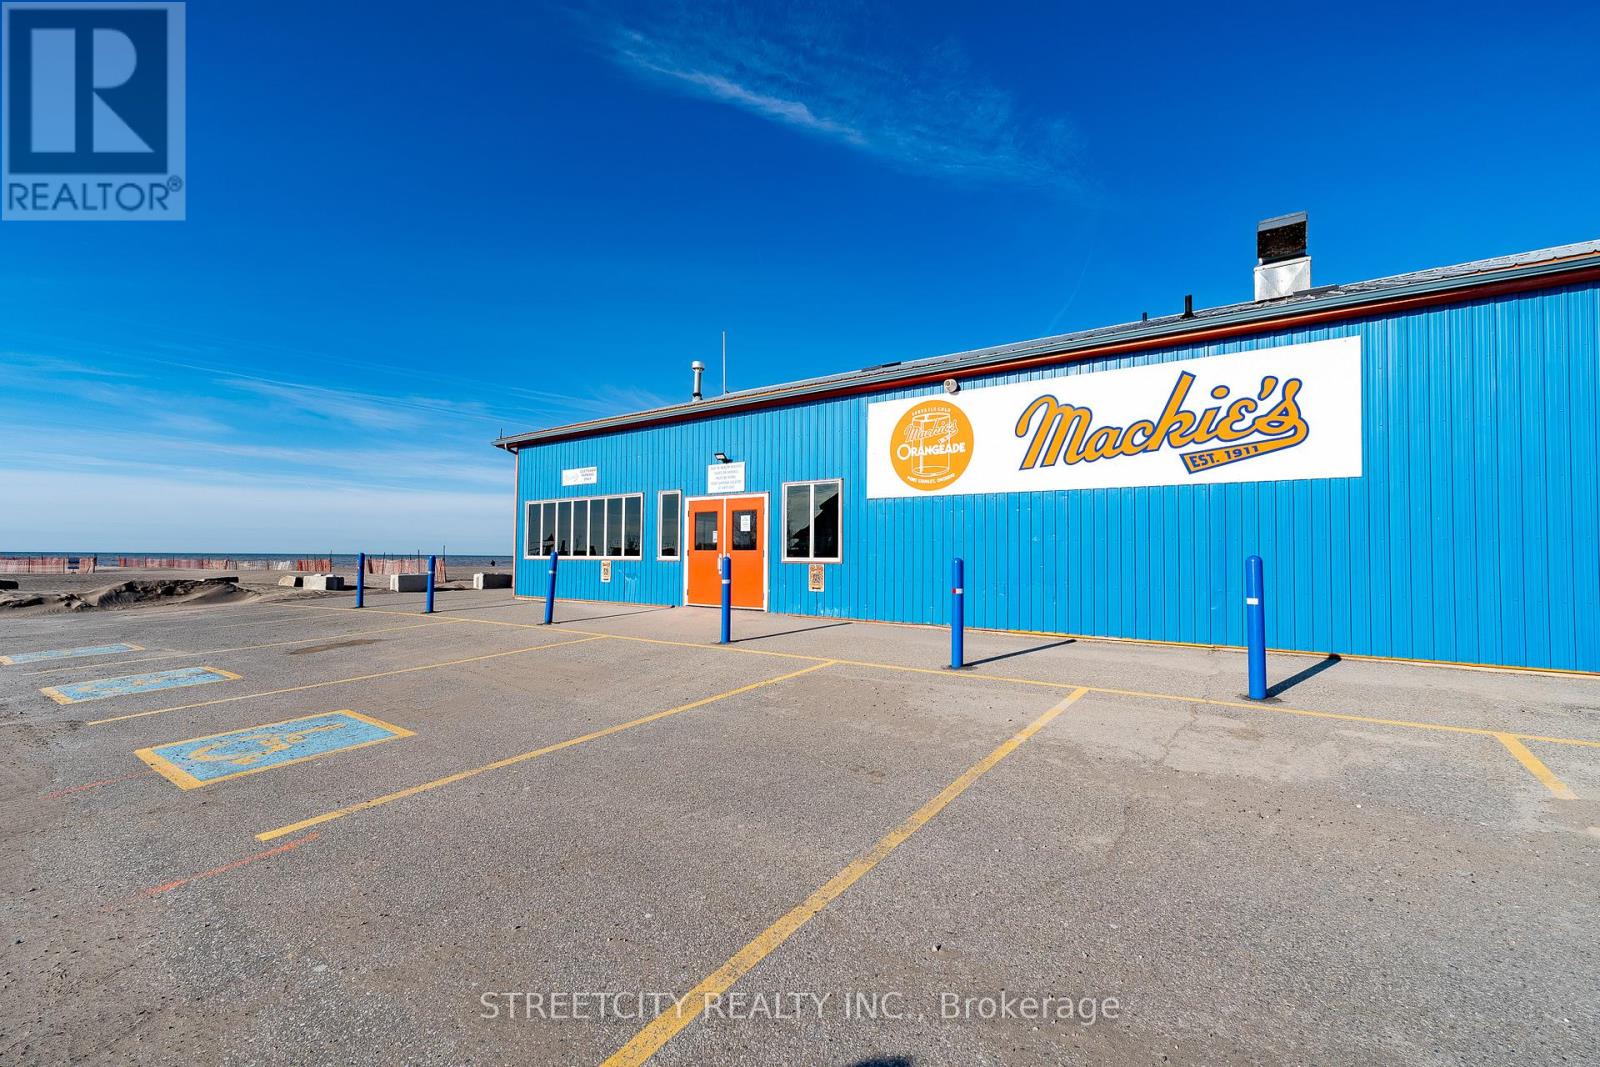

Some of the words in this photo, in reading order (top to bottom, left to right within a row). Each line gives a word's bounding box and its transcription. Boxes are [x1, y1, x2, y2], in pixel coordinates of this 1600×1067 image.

[1015, 370, 1310, 471] Mackie's
[897, 442, 966, 461] ORANGEADE
[1189, 453, 1220, 468] EST.
[1224, 445, 1259, 460] 1911
